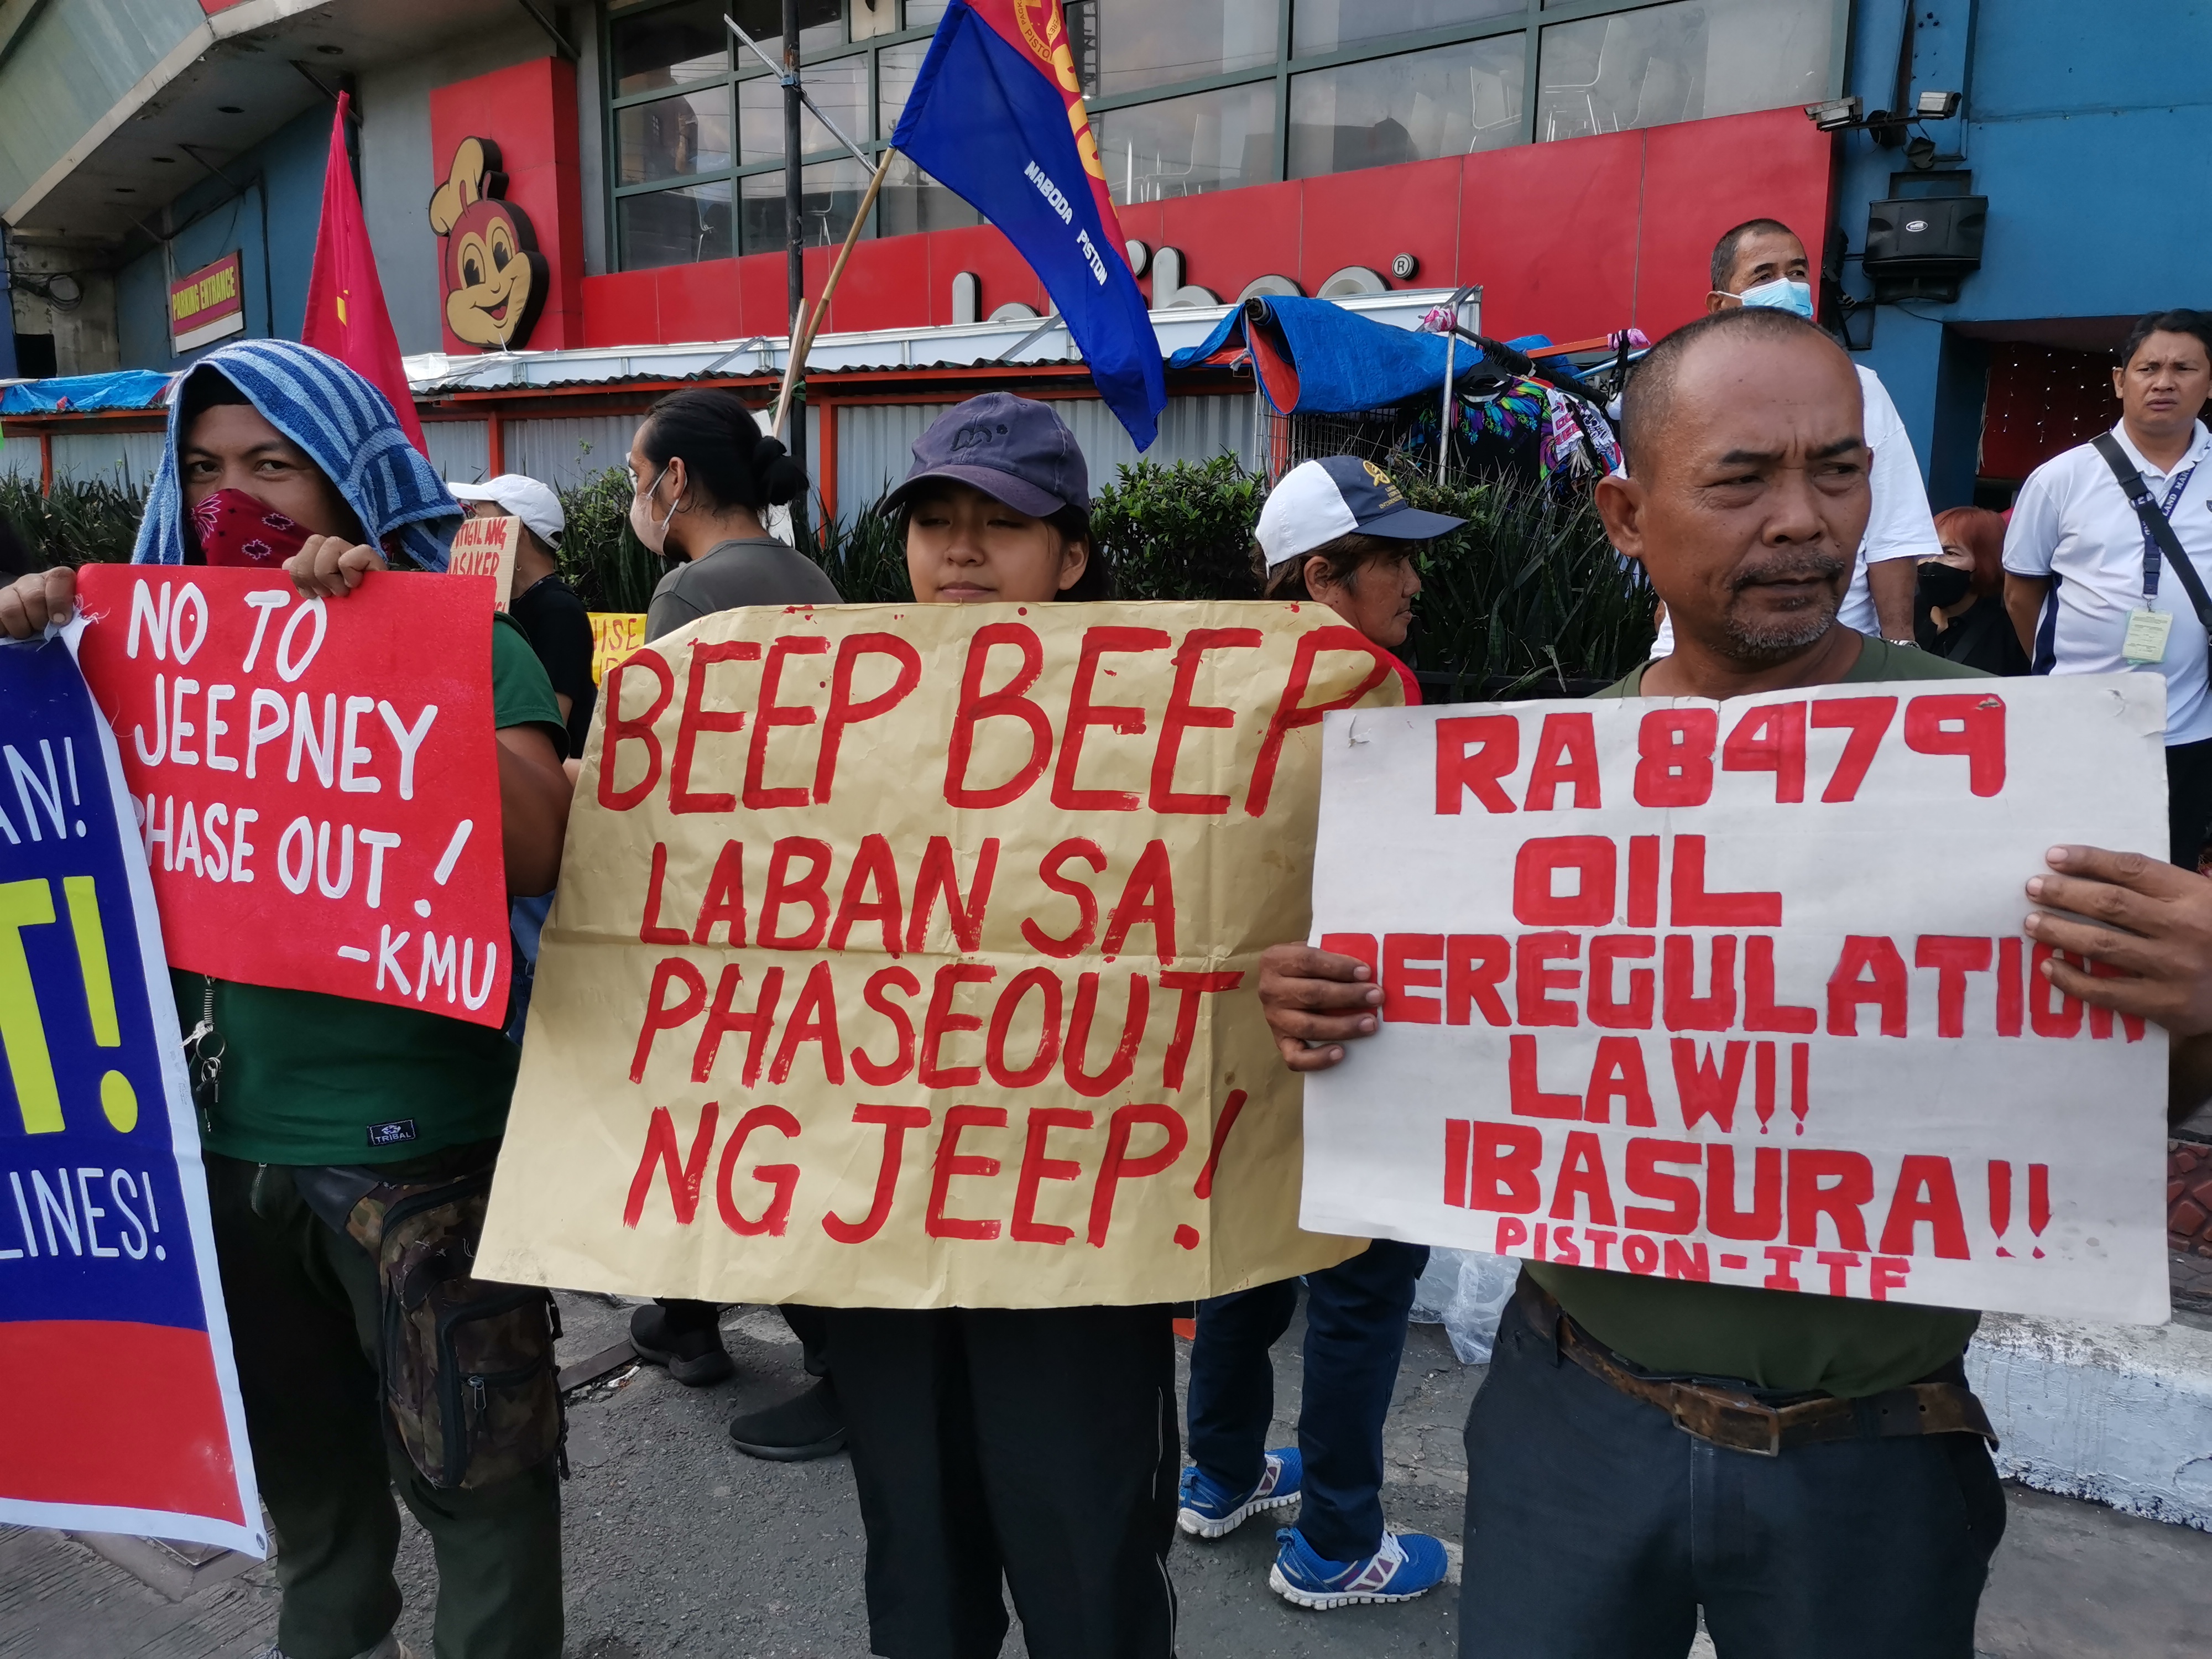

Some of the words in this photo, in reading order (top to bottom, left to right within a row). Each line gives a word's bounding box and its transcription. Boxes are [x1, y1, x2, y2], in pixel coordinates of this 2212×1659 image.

[1018, 0, 1027, 25] PAGK
[1024, 160, 1073, 225] MABODA
[173, 284, 200, 321] PARKING
[200, 266, 235, 310] ENTRANCE
[484, 517, 507, 550] ANG
[127, 579, 208, 665] NO
[243, 590, 327, 682] TO
[135, 673, 439, 800] JEEPNEY
[598, 633, 922, 815] BEEP
[943, 623, 1394, 818] BEEP
[1435, 712, 1601, 815] RA
[1634, 693, 2006, 808] 8479
[0, 737, 87, 844] N!
[640, 834, 1000, 953] LABAN
[1021, 837, 1177, 965] SA
[1513, 834, 1782, 928] OIL
[629, 957, 1245, 1097] PHASEOUT
[1509, 1035, 1809, 1135] LAW!!
[374, 1131, 411, 1143] TRIBAL
[623, 1102, 801, 1237] NG
[822, 1089, 1248, 1250] JEEP!
[1495, 1217, 1911, 1301] PISTON-ITF
